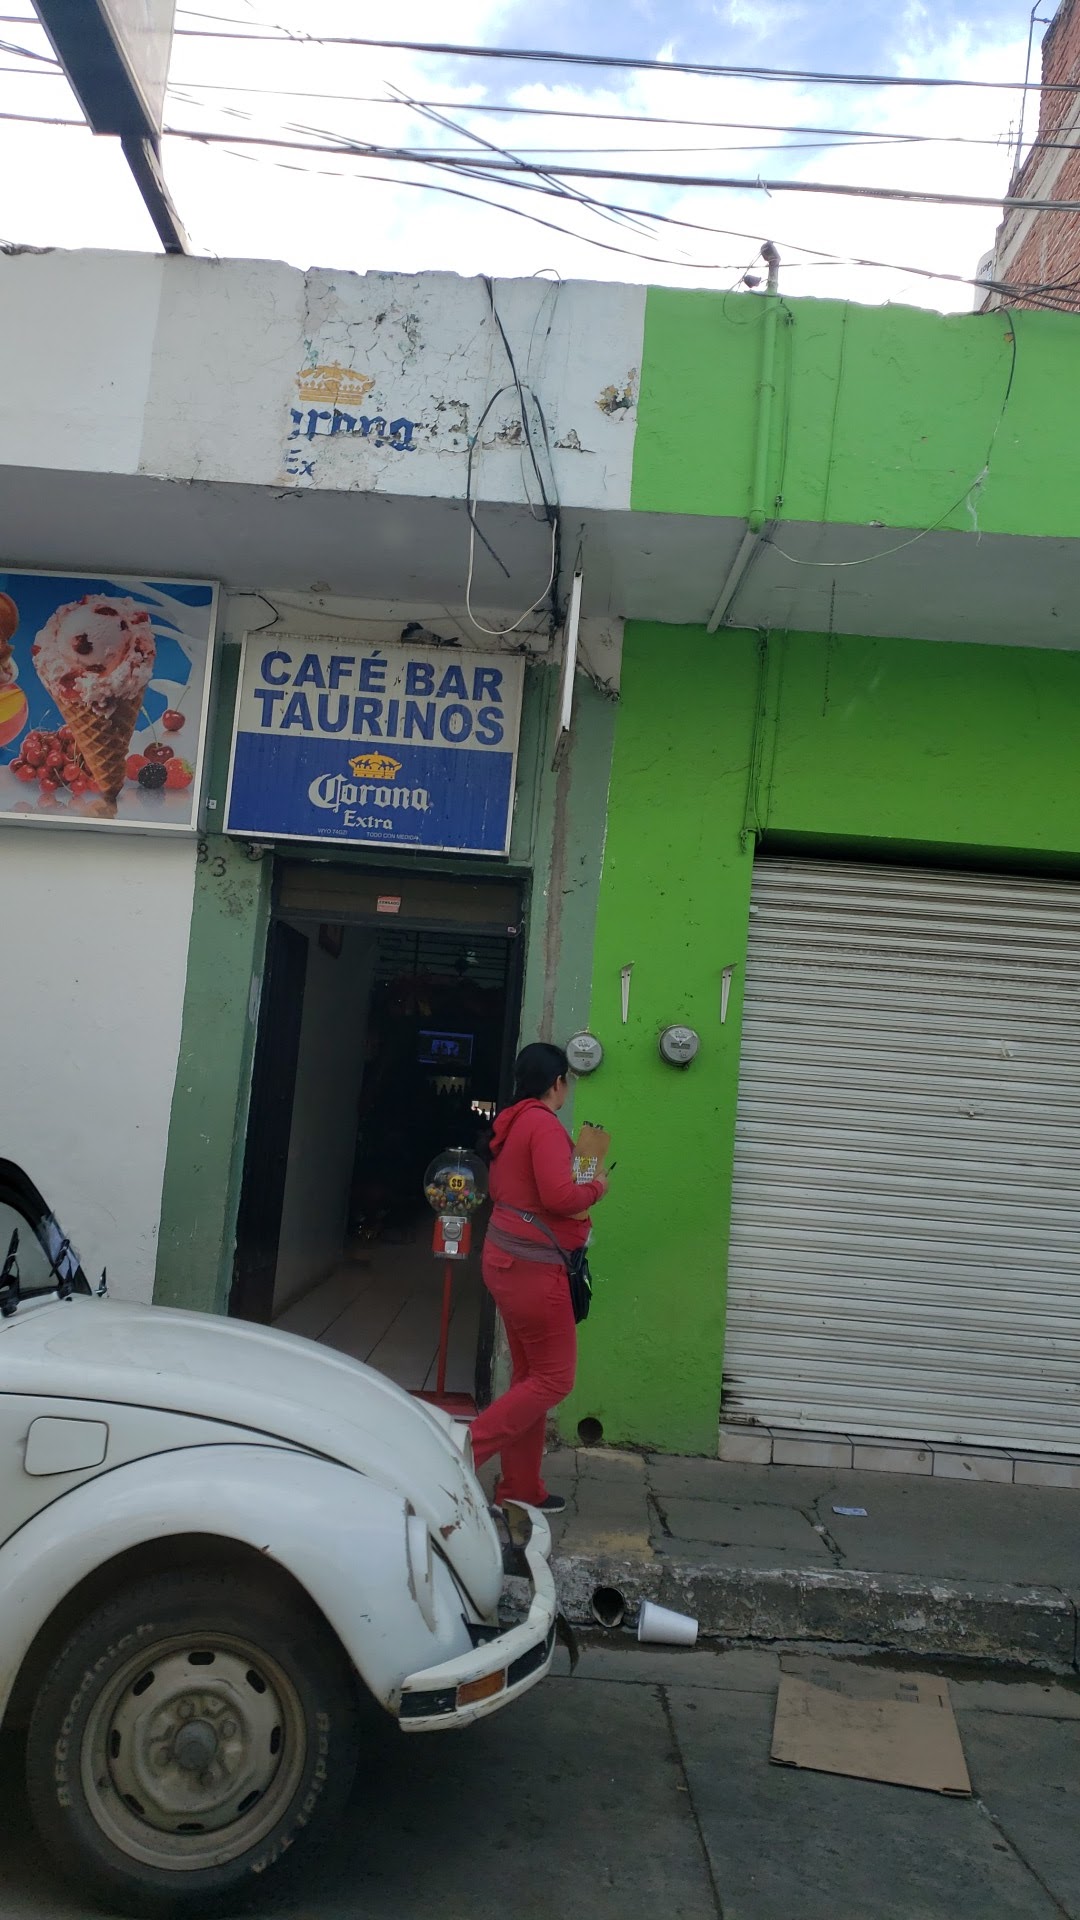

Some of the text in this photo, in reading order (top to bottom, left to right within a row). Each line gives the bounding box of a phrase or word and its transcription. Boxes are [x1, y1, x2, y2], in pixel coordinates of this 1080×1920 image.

[260, 651, 503, 702] CAFÉ BAR
[254, 688, 505, 745] TAURINOS
[308, 773, 430, 813] Corona
[343, 809, 393, 829] Extra
[451, 1178, 463, 1188] $5
